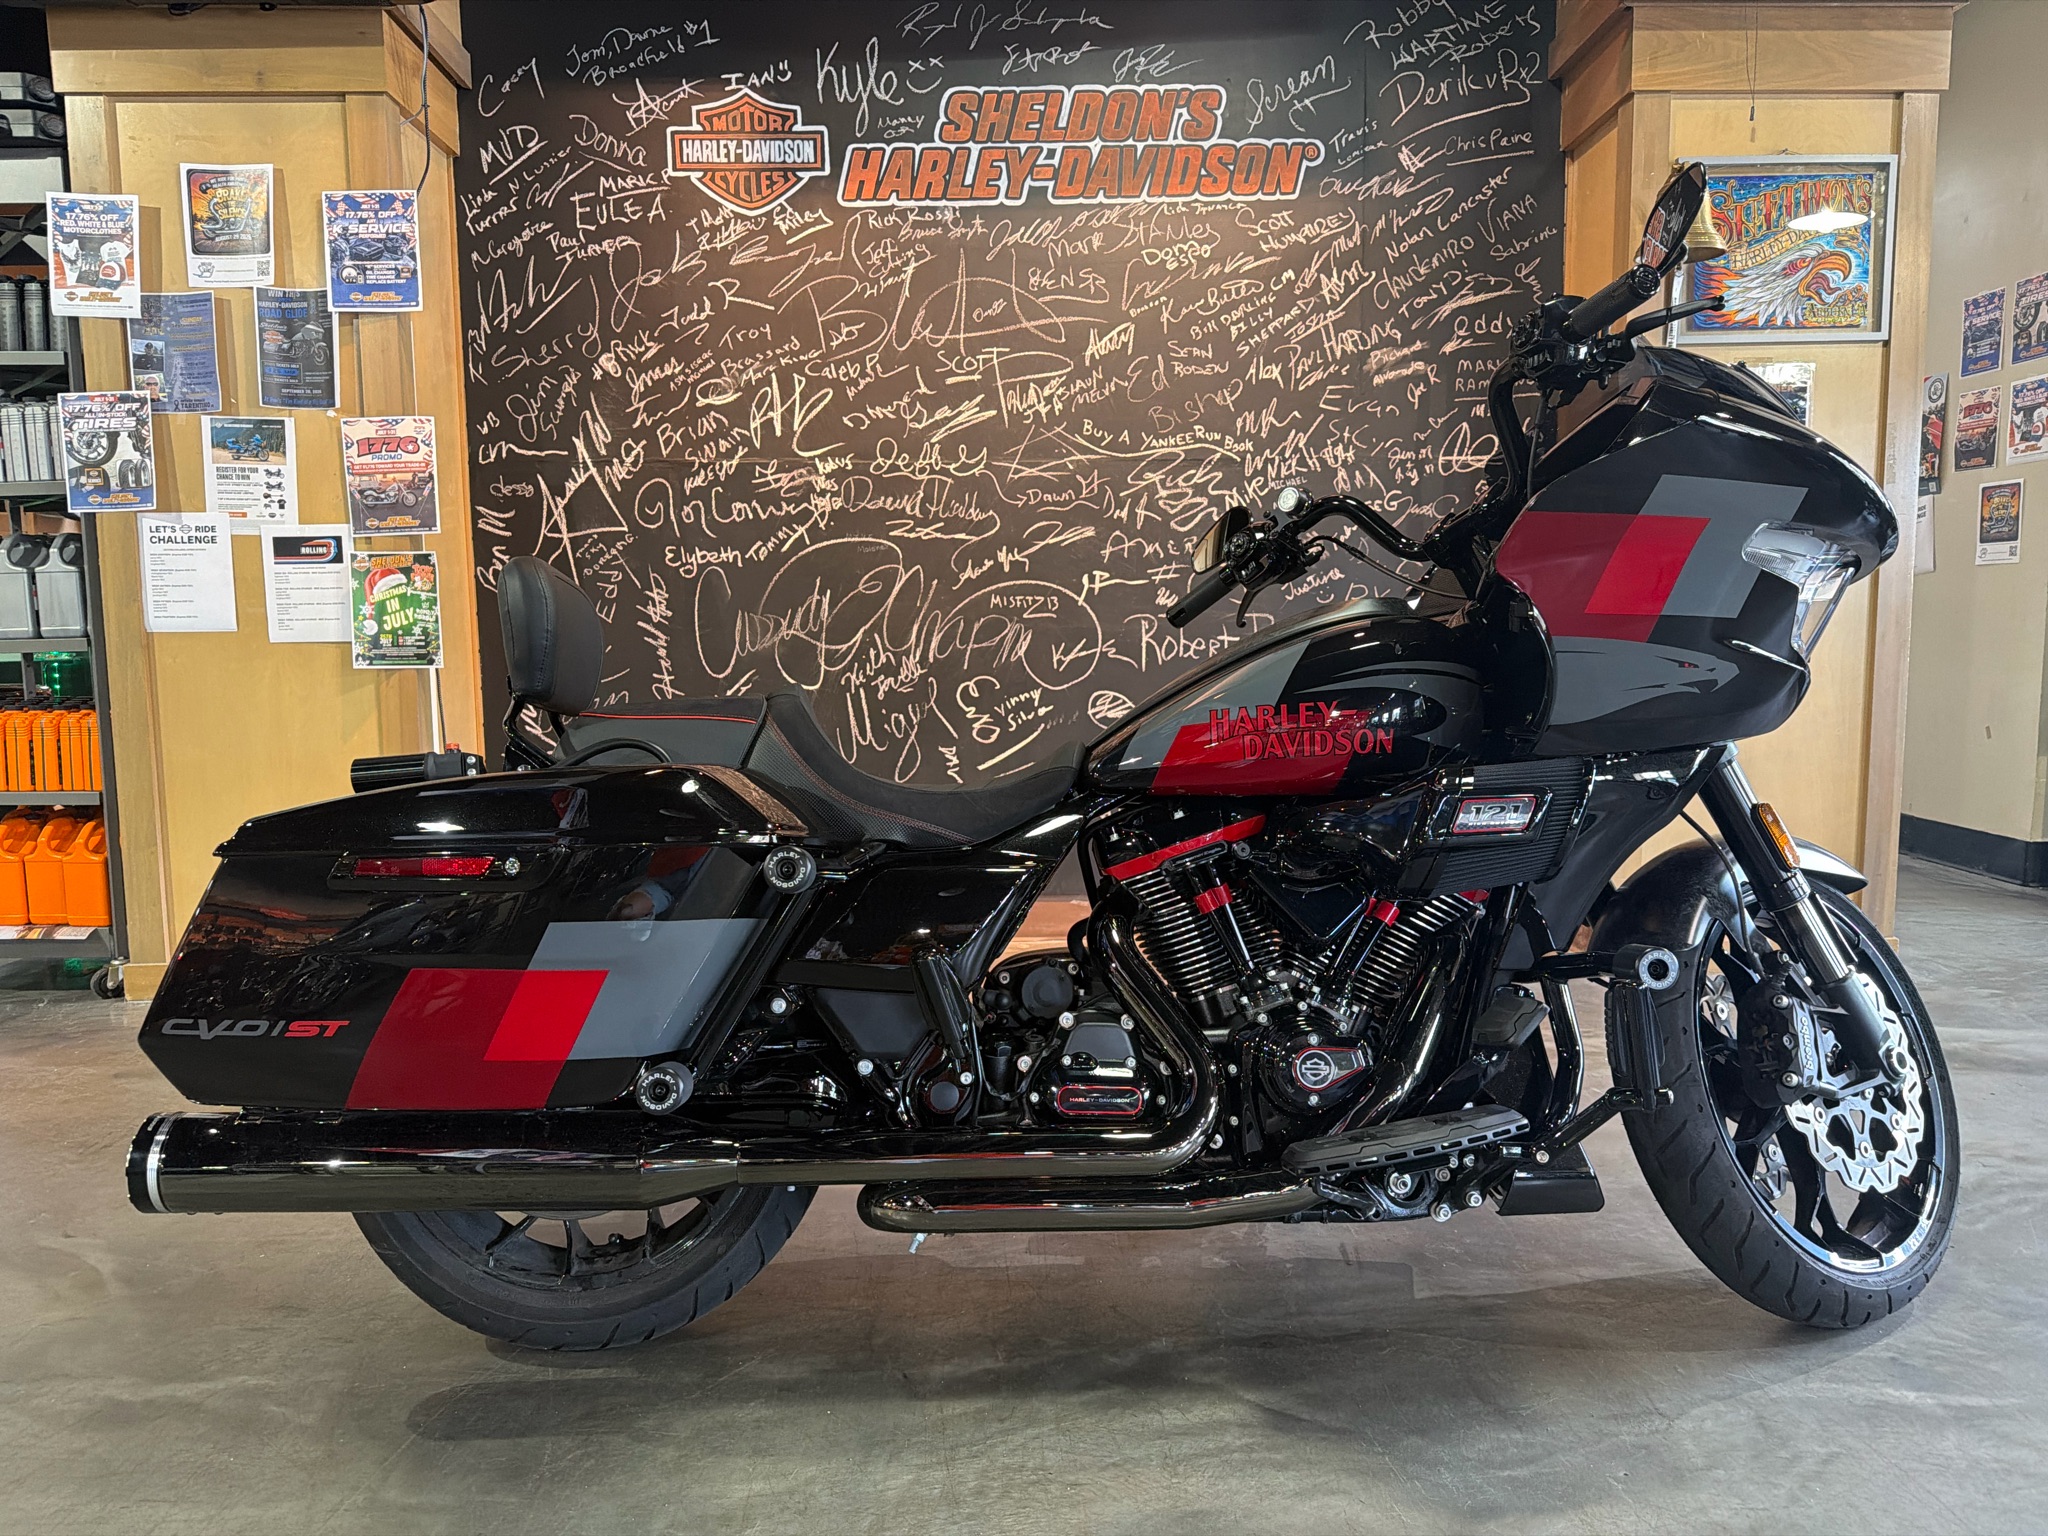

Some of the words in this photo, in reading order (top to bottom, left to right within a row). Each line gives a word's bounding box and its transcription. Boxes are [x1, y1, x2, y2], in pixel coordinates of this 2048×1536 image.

[816, 37, 904, 137] Kyle
[712, 104, 784, 132] MOTOR
[939, 88, 1221, 143] SHELDON'S
[569, 114, 647, 166] Donna
[1444, 129, 1488, 156] Chris
[682, 139, 814, 164] HARLEY-DAVIDSON
[713, 172, 786, 201] CYCLES
[65, 213, 98, 221] 17.76%
[100, 213, 119, 221] OFF
[333, 224, 342, 233] K
[348, 223, 411, 233] SERVICE
[546, 229, 586, 253] Paul
[1385, 227, 1434, 263] Nolan
[259, 308, 282, 318] ROAD
[285, 309, 307, 318] GLIDE
[718, 323, 772, 350] Troy
[805, 359, 860, 381] Caleb
[1245, 356, 1284, 389] Alex
[68, 404, 110, 412] 17.76%
[115, 403, 140, 411] OFF
[75, 418, 136, 429] TIRES
[656, 411, 729, 457] Brian
[357, 436, 420, 458] 1776
[1119, 430, 1130, 445] A
[1141, 432, 1194, 450] YANKEE
[149, 525, 177, 533] LET'S
[195, 525, 217, 533] RIDE
[149, 535, 218, 544] CHALLENGE
[370, 584, 407, 603] CHRISTMAS
[386, 597, 401, 613] IN
[383, 607, 415, 631] JULY
[1241, 728, 1394, 761] DAVIDSON
[1469, 804, 1522, 822] 121
[768, 851, 800, 869] HARLEY
[770, 867, 806, 888] DAVIDSON
[1642, 952, 1673, 965] HARLEY
[1641, 971, 1676, 988] DAVIDSON
[1801, 1016, 1814, 1071] brembo
[642, 1073, 676, 1087] HARLEY
[640, 1093, 677, 1111] DAVIDSON
